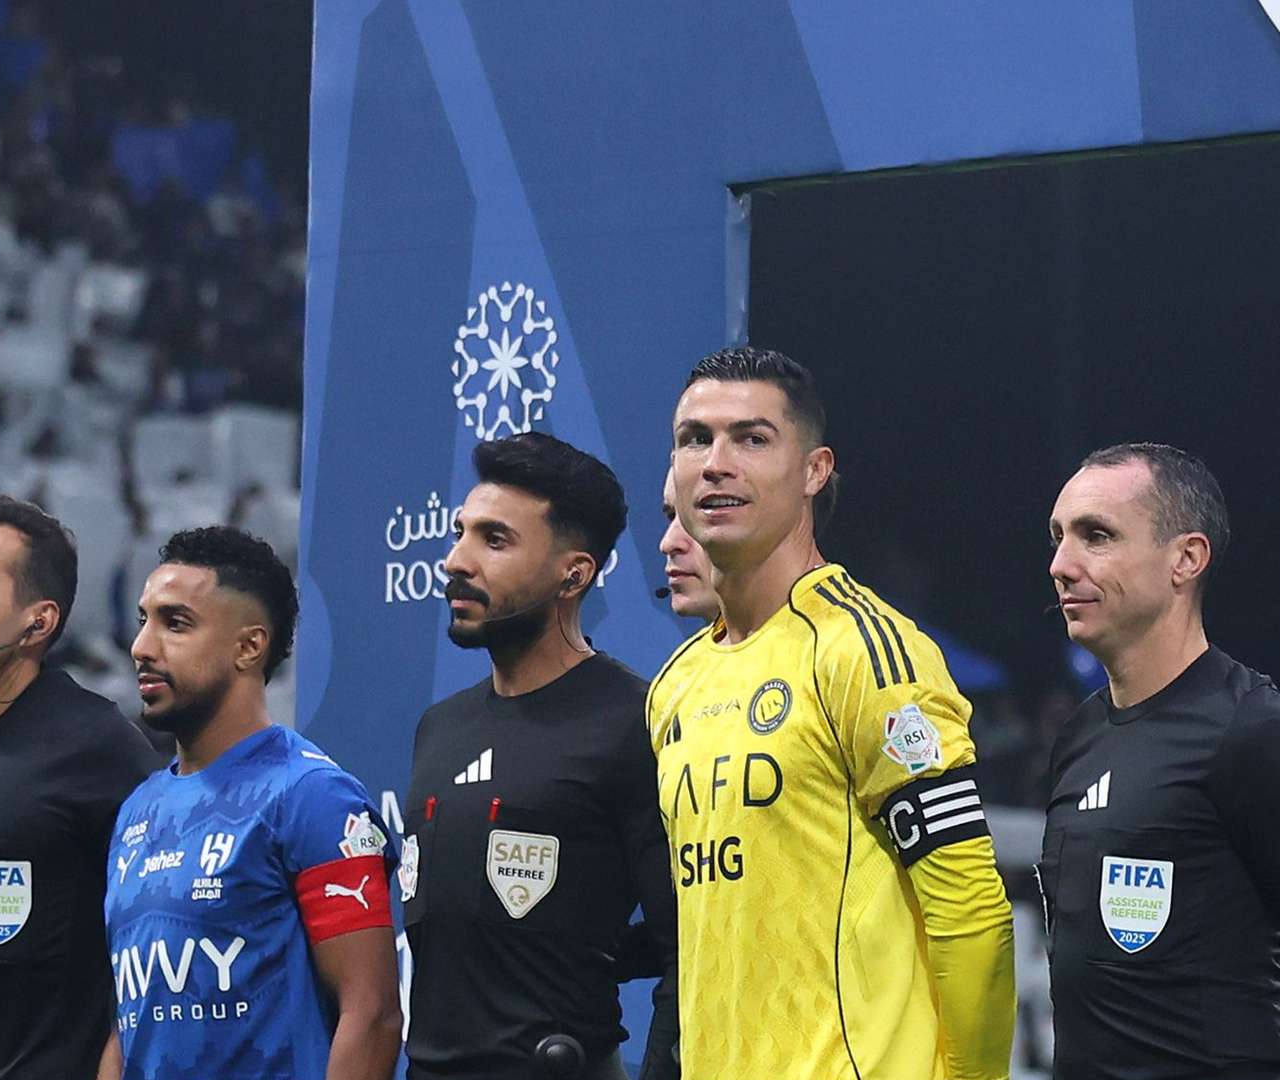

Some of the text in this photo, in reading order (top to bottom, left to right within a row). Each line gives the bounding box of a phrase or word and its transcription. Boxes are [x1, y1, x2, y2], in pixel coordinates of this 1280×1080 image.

[385, 560, 451, 603] ROS
[904, 729, 928, 746] RSL
[659, 752, 783, 819] AFD
[889, 800, 920, 849] C
[494, 841, 553, 866] SAFF
[679, 836, 744, 888] SHG
[497, 866, 545, 881] REFEREE
[1108, 863, 1165, 889] FIFA
[1107, 896, 1163, 911] ASSISTANT
[1110, 907, 1158, 921] REFEREE
[1119, 930, 1146, 945] 2025
[152, 1001, 249, 1021] GROUP
